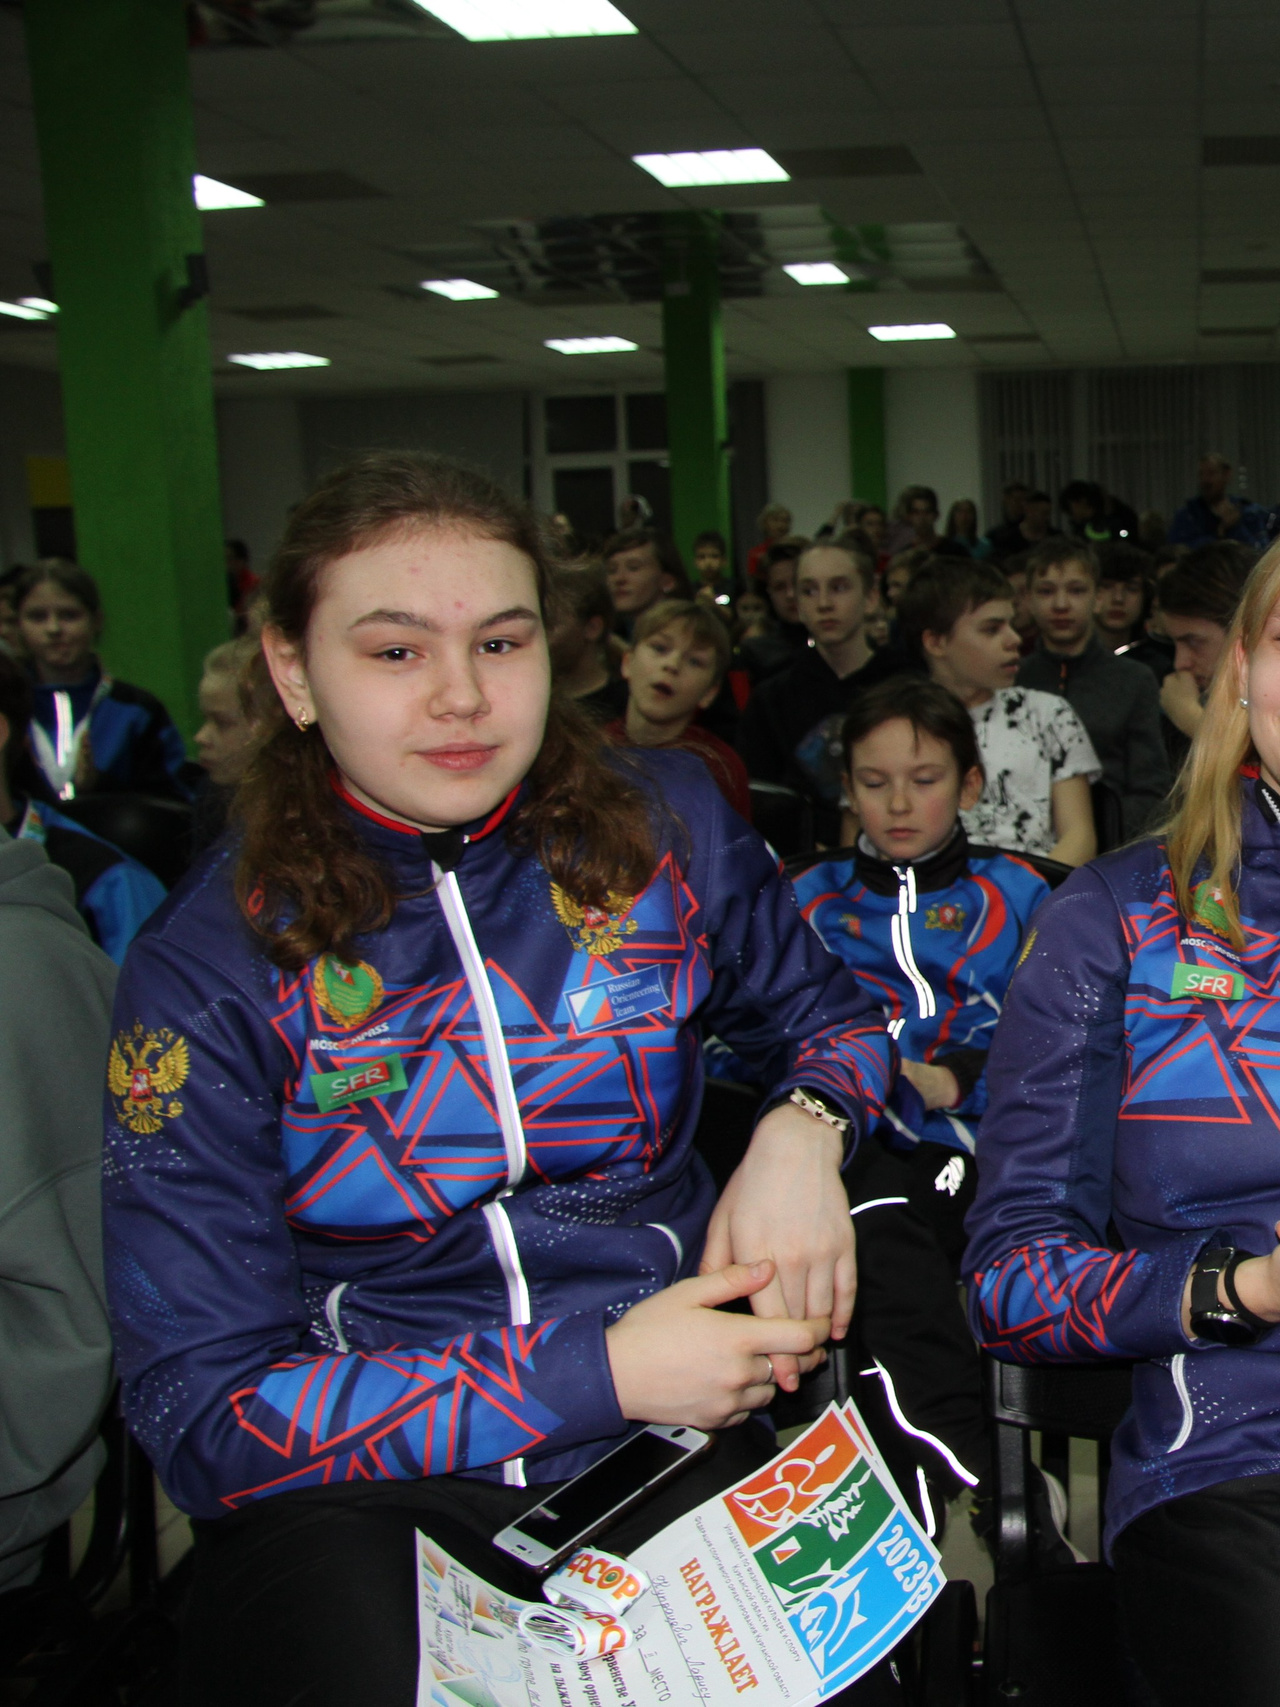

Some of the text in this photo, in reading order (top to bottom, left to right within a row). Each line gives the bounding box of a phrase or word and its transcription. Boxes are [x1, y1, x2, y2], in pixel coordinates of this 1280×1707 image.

[607, 978, 641, 994] Russian
[611, 983, 661, 1005] Orienteering
[1184, 973, 1228, 996] SFR
[613, 1004, 636, 1017] Team
[330, 1067, 385, 1097] SFR
[876, 1524, 929, 1592] 2023
[679, 1556, 760, 1694] НАГРАЖДАЕТ
[549, 1662, 562, 1674] на
[633, 1624, 647, 1642] за
[650, 1667, 672, 1702] место
